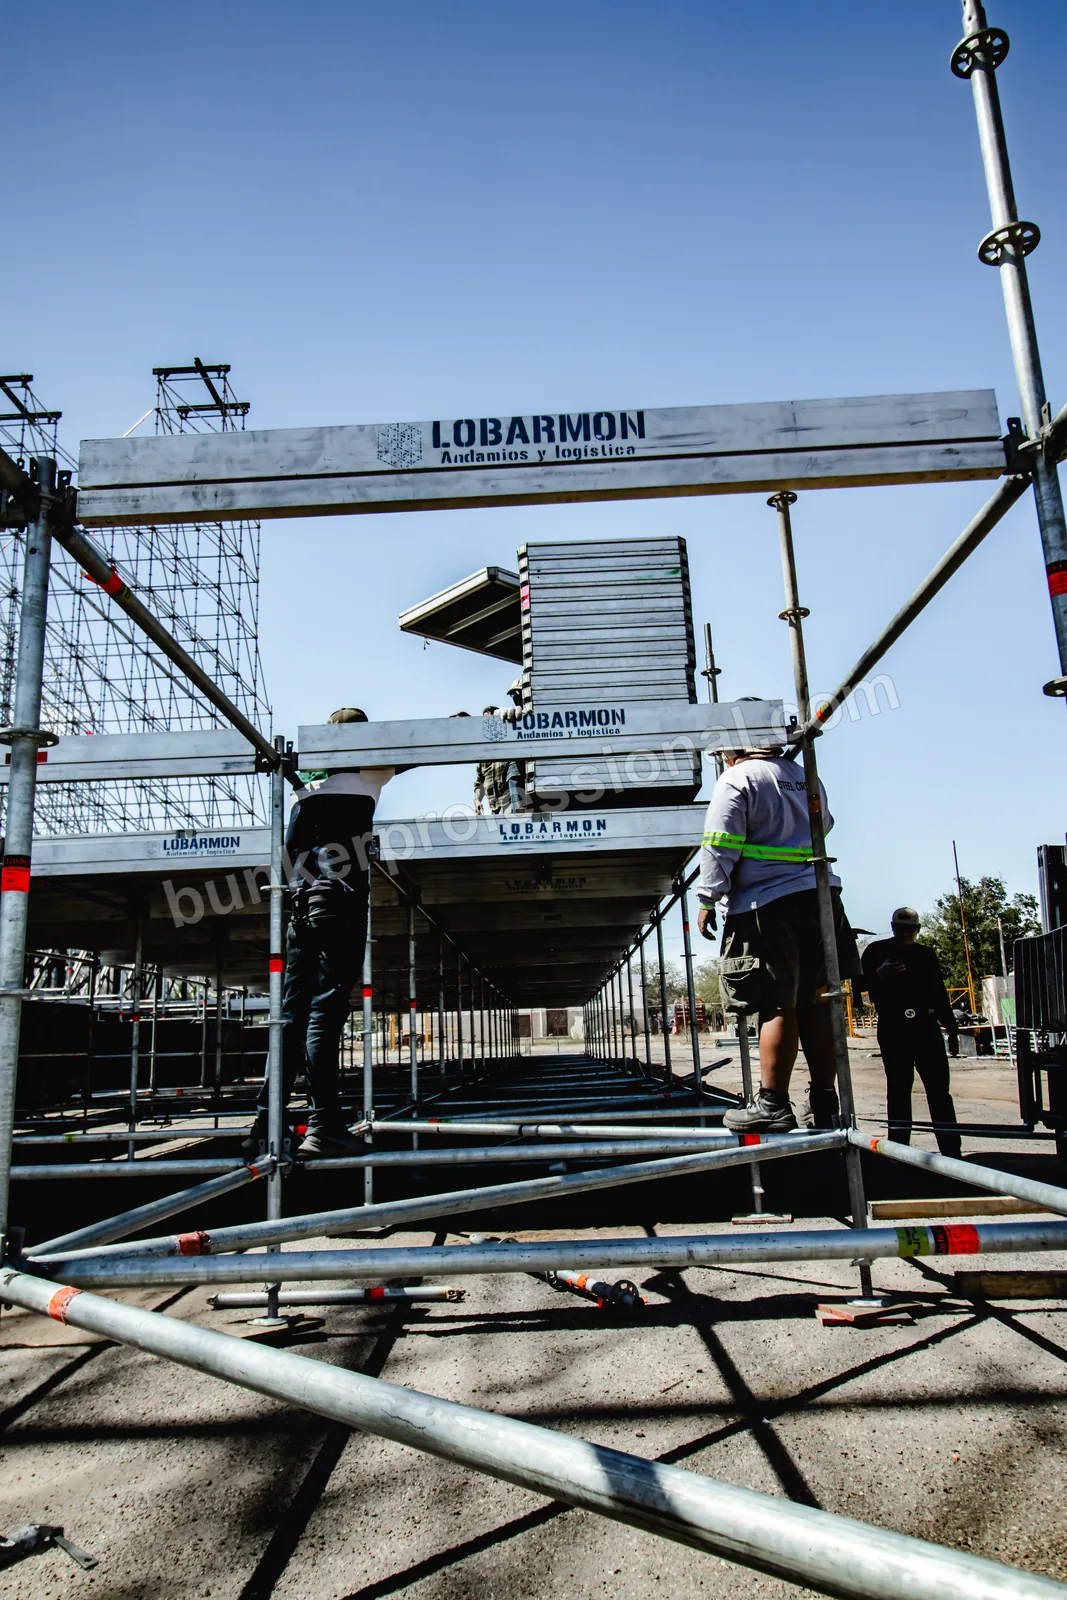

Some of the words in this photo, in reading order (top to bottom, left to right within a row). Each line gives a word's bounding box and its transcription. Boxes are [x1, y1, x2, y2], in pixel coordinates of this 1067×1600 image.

[432, 411, 645, 448] LOBARMON
[441, 448, 528, 464] Andamios
[537, 449, 547, 462] y
[512, 709, 625, 730] LOBARMON
[517, 731, 564, 740] Andamios
[777, 780, 795, 791] STEEL
[796, 781, 807, 791] CR
[499, 819, 606, 835] LOBARMON
[163, 836, 240, 850] LOBARMON
